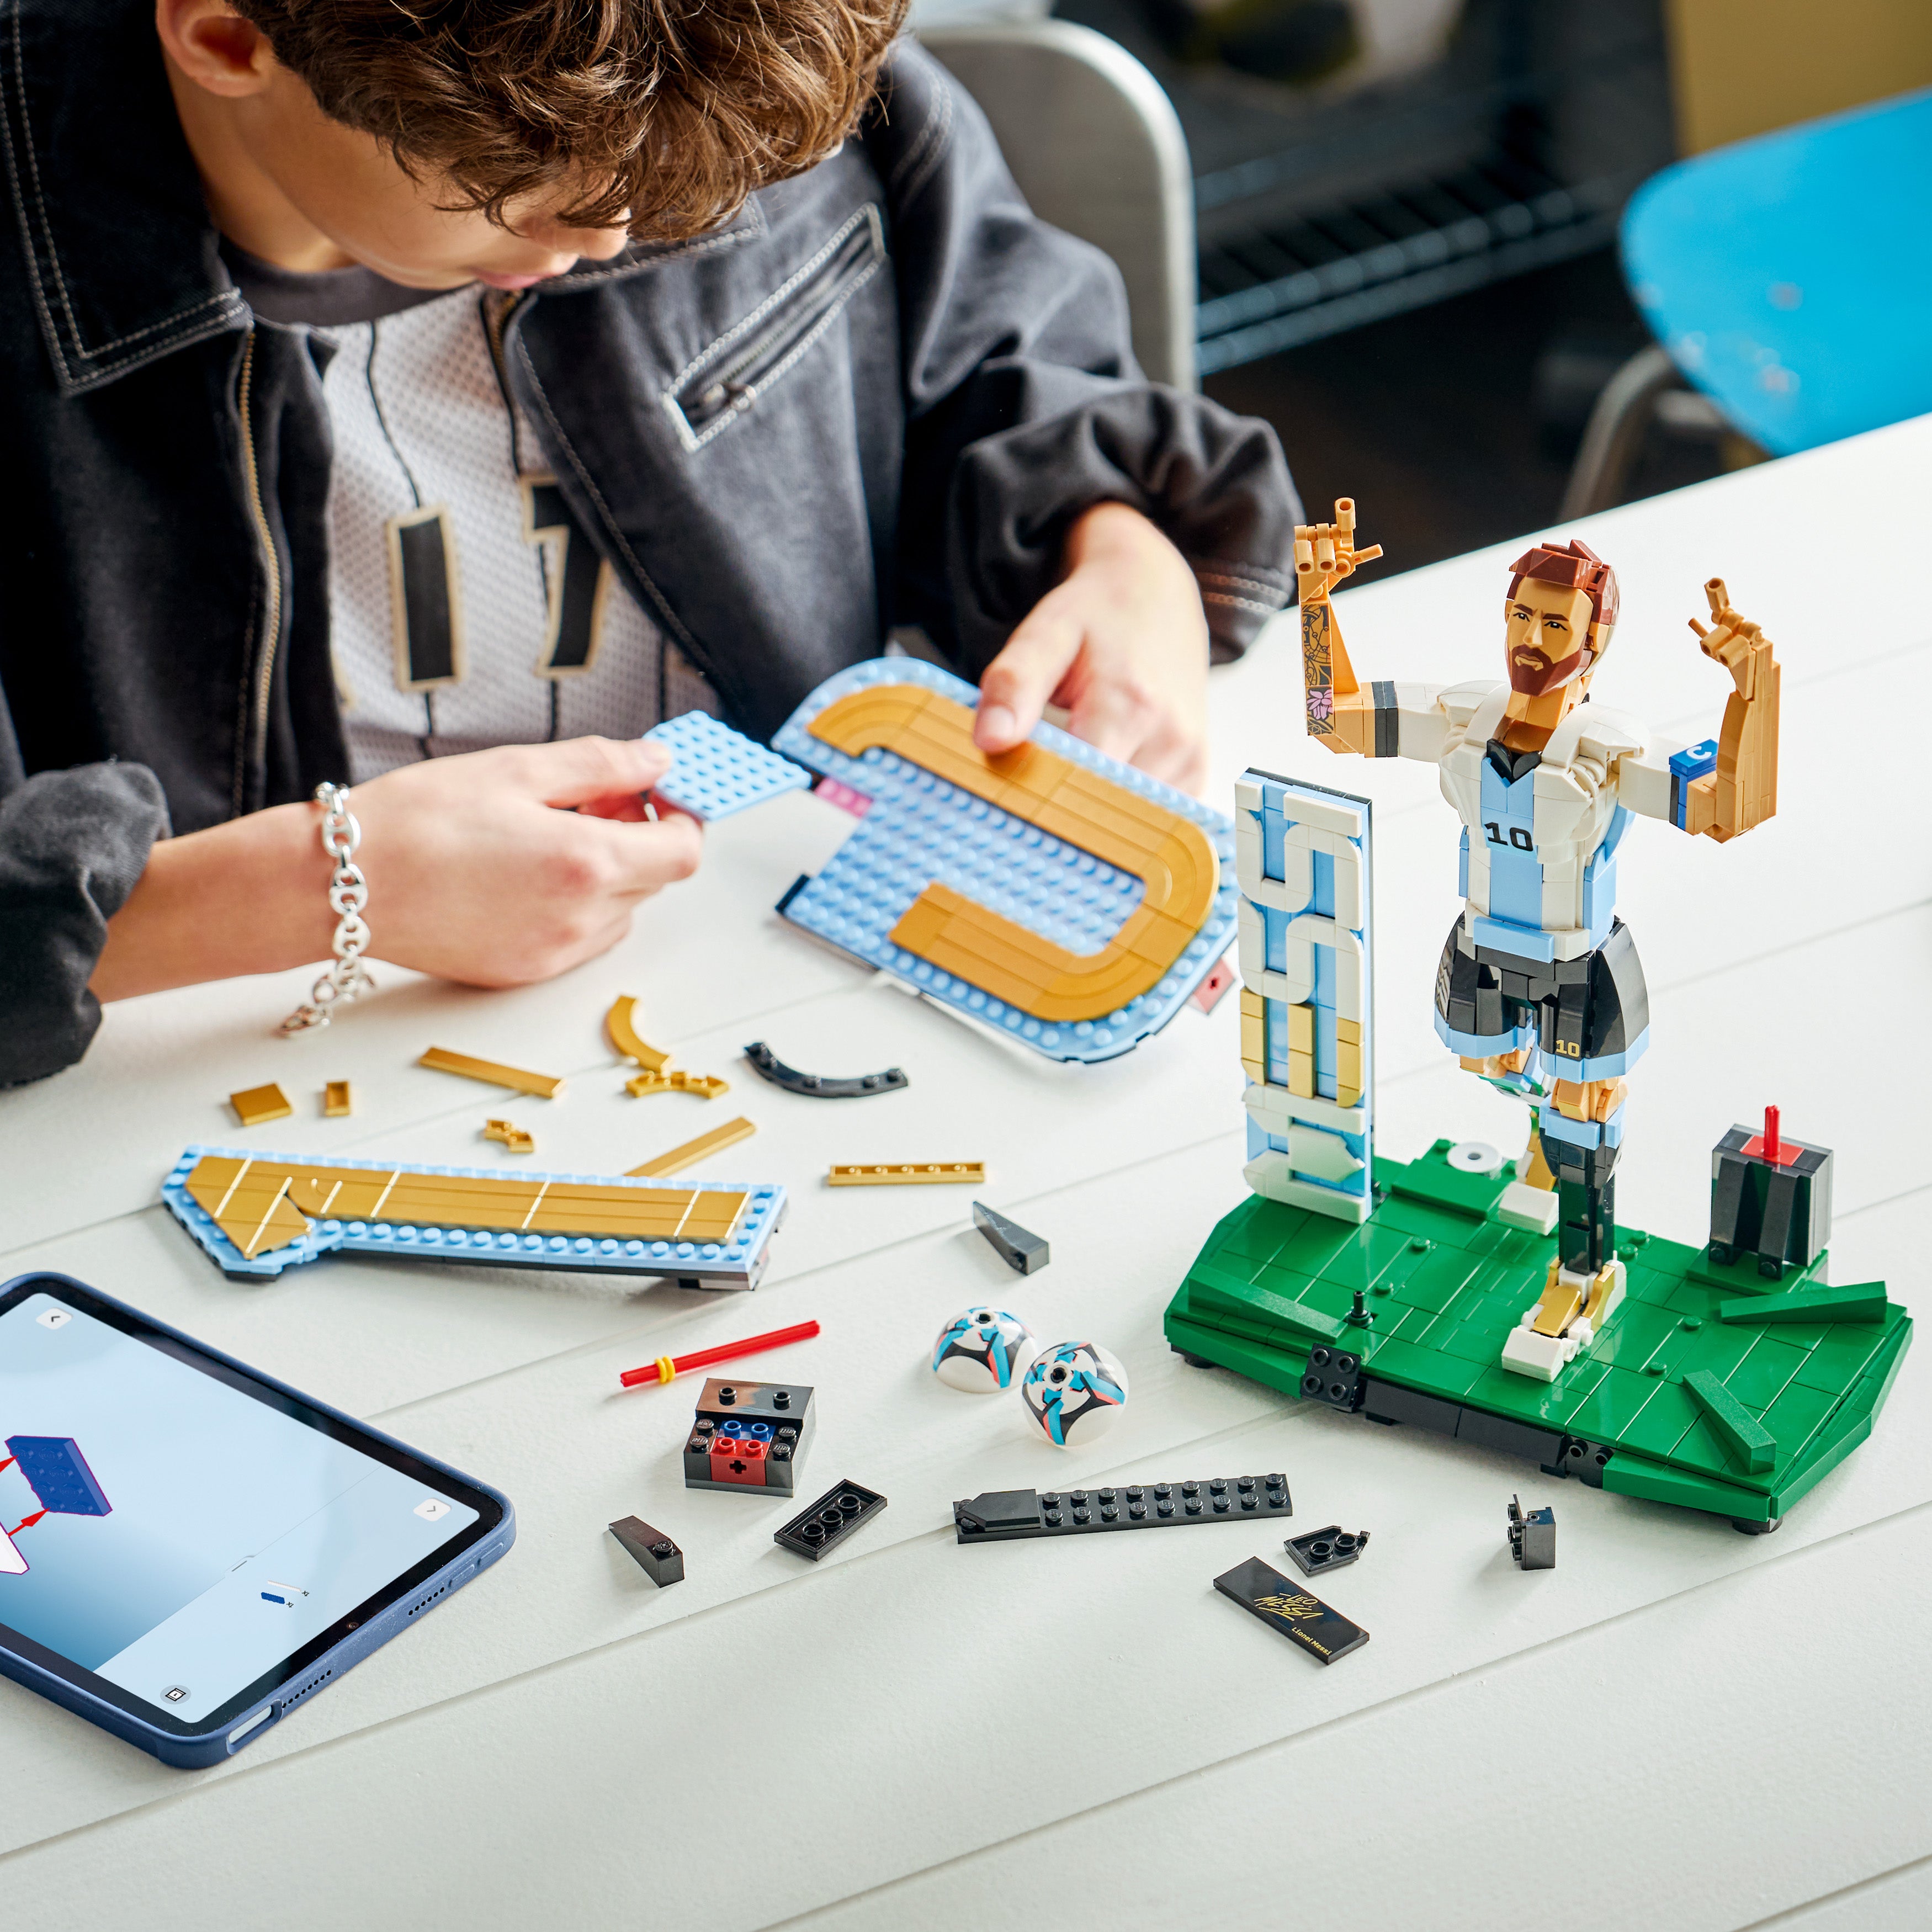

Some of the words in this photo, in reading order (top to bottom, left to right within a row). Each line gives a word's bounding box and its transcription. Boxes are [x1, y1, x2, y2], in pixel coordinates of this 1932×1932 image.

[1687, 746, 1712, 760] C
[1484, 822, 1533, 852] 10
[1556, 1039, 1580, 1058] 10
[1291, 1627, 1313, 1642] Lionel
[1311, 1641, 1333, 1655] Messi
